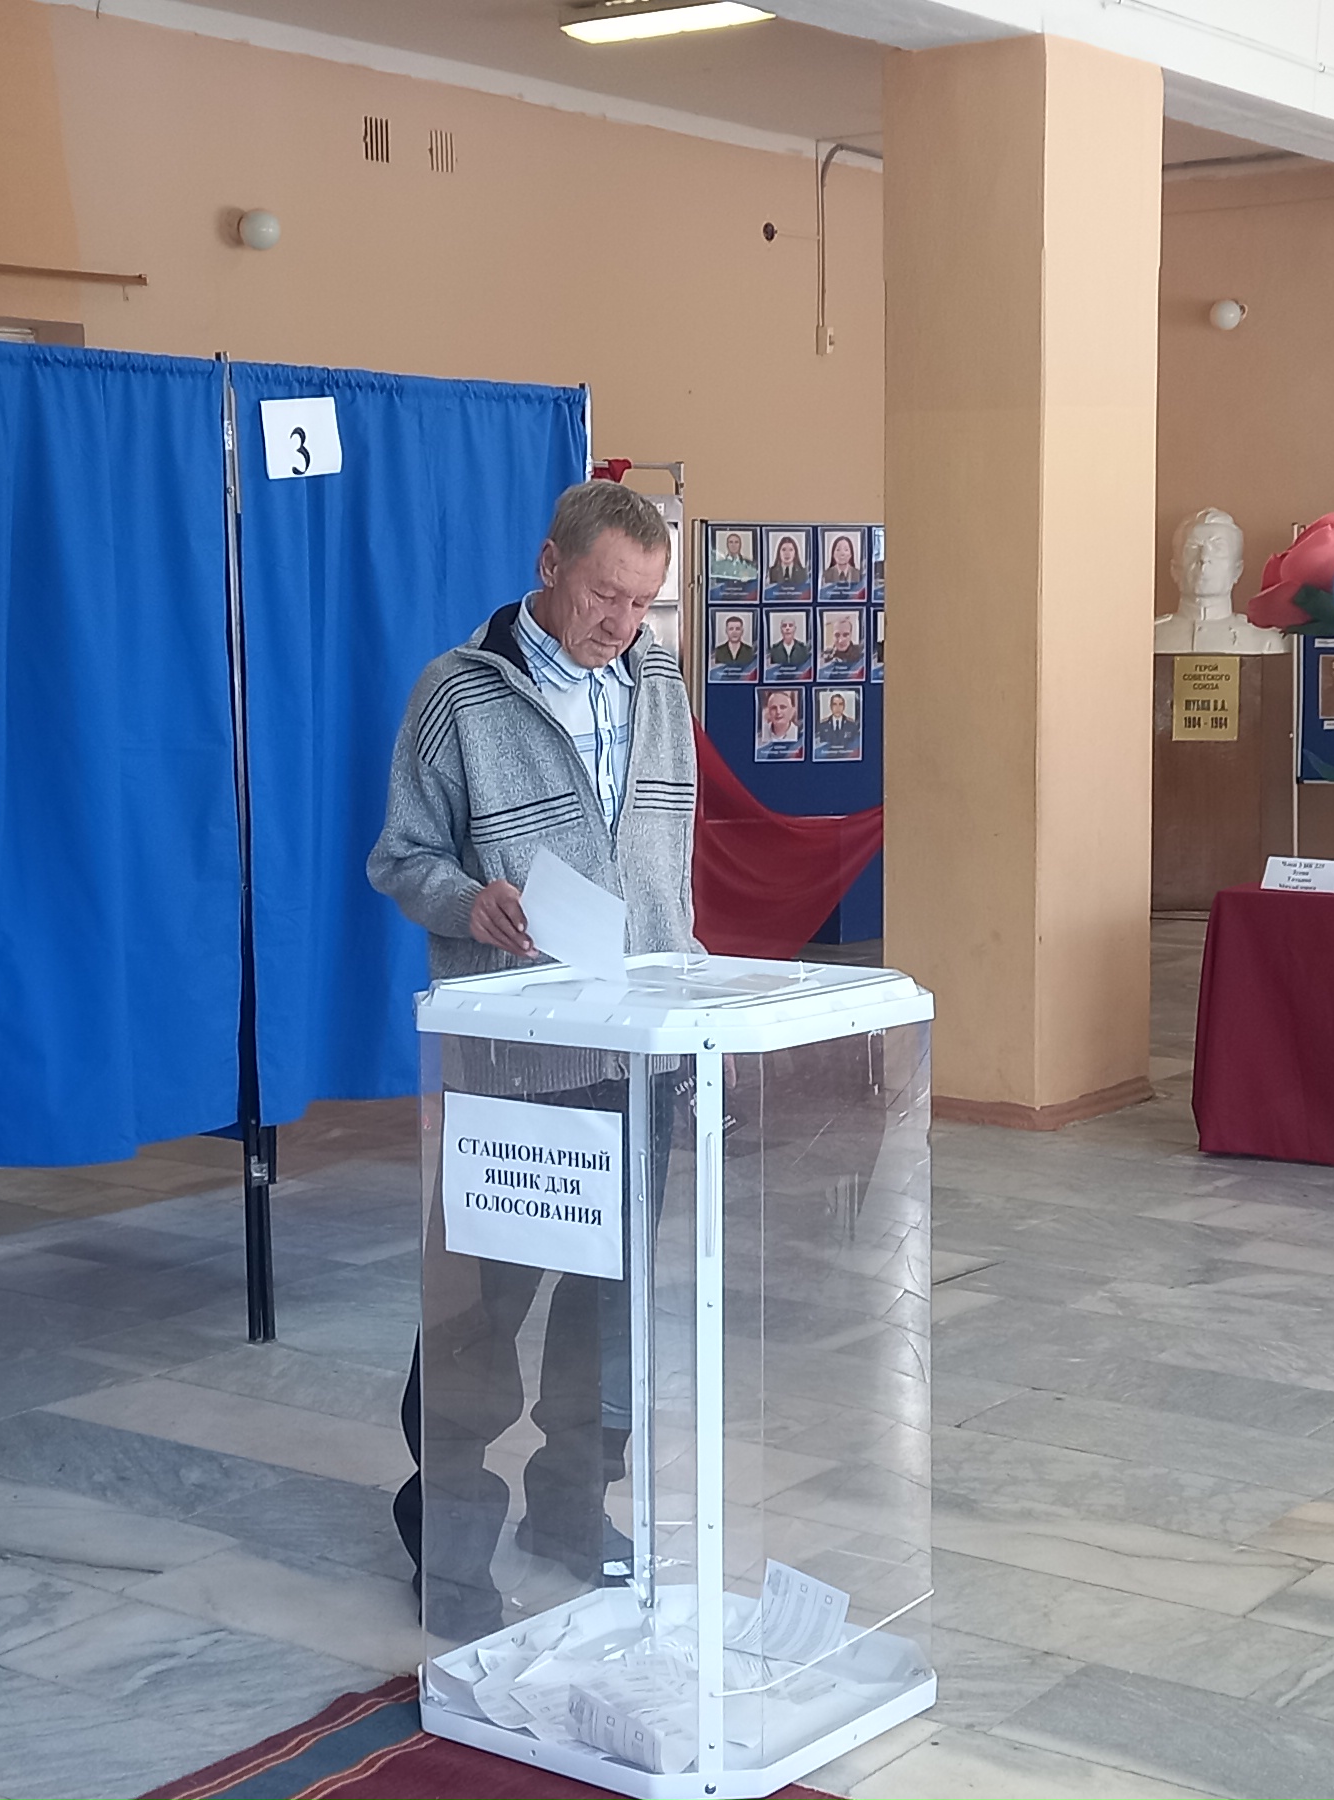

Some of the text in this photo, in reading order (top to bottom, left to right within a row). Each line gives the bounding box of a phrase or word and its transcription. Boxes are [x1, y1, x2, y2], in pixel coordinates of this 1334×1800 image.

[289, 426, 311, 476] 3
[1182, 673, 1231, 681] СОВЕТСКОГО
[1195, 663, 1219, 672] ГЕРОЙ
[1192, 682, 1220, 690] СОЮЗА
[457, 1136, 611, 1173] СТАЦИОНАРНЫЙ
[483, 1168, 582, 1196] ЯЩИК ДЛЯ
[464, 1191, 603, 1227] ГОЛОСОВАНИЯ
